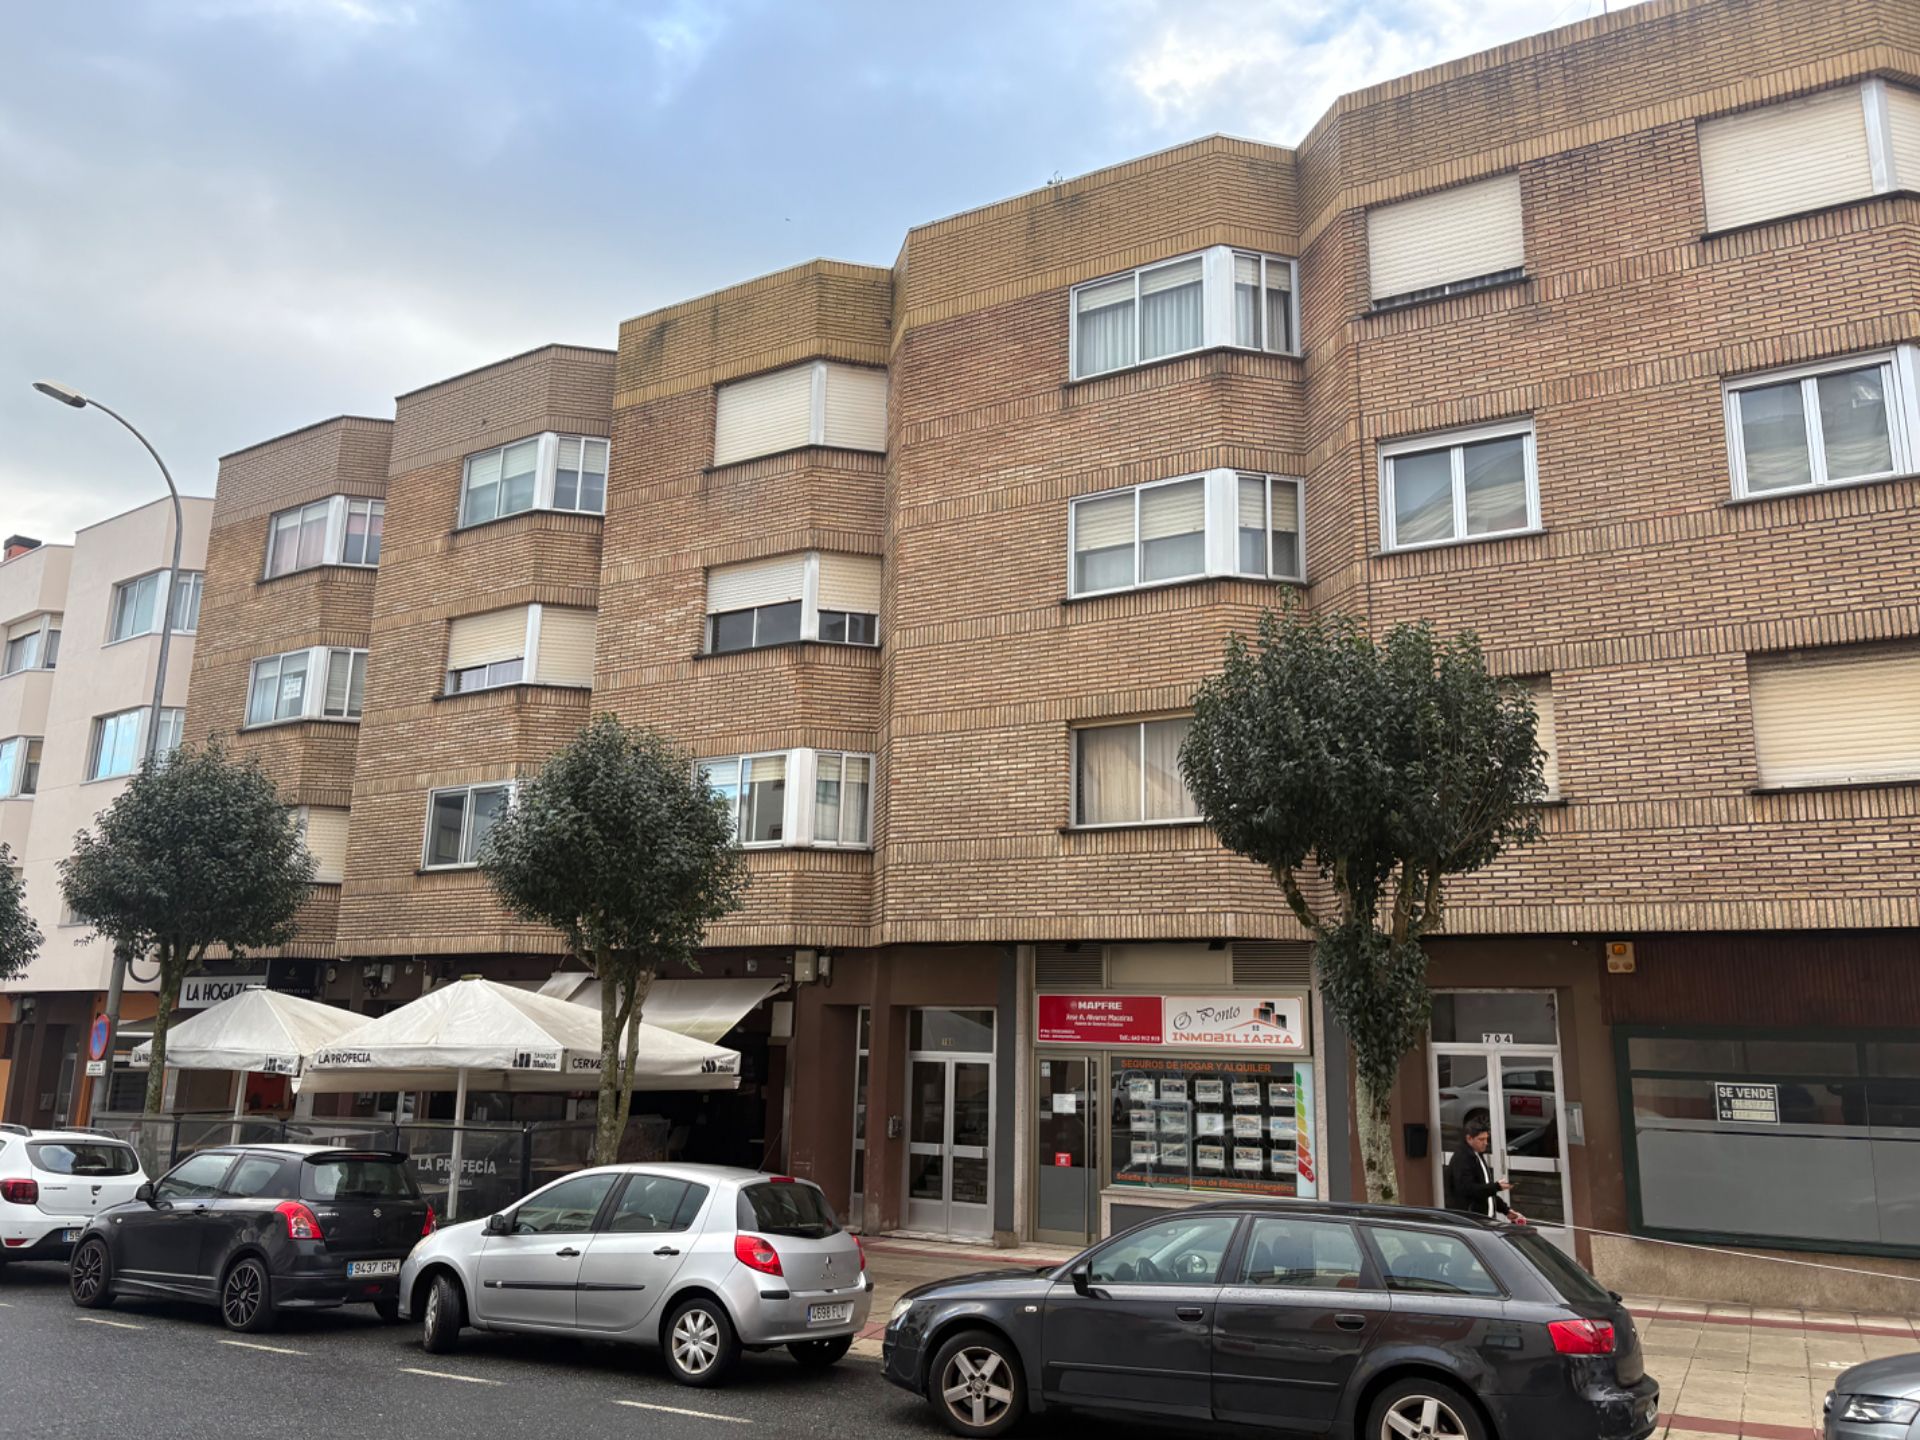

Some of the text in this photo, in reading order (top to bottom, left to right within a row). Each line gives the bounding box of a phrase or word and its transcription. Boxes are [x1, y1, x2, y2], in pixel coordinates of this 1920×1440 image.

[186, 984, 199, 1001] LA
[1078, 1001, 1122, 1010] MAPFRE
[1173, 1006, 1241, 1030] O Ponto
[1172, 1032, 1294, 1044] INMOBILIARIA
[318, 1053, 371, 1064] LA PROFECIA
[1121, 1059, 1271, 1073] SEGUROS DE HOGAR Y ALQUILER
[1719, 1087, 1774, 1099] SE VENDE
[418, 1158, 433, 1171] LA
[354, 1261, 399, 1274] 9437 GPK
